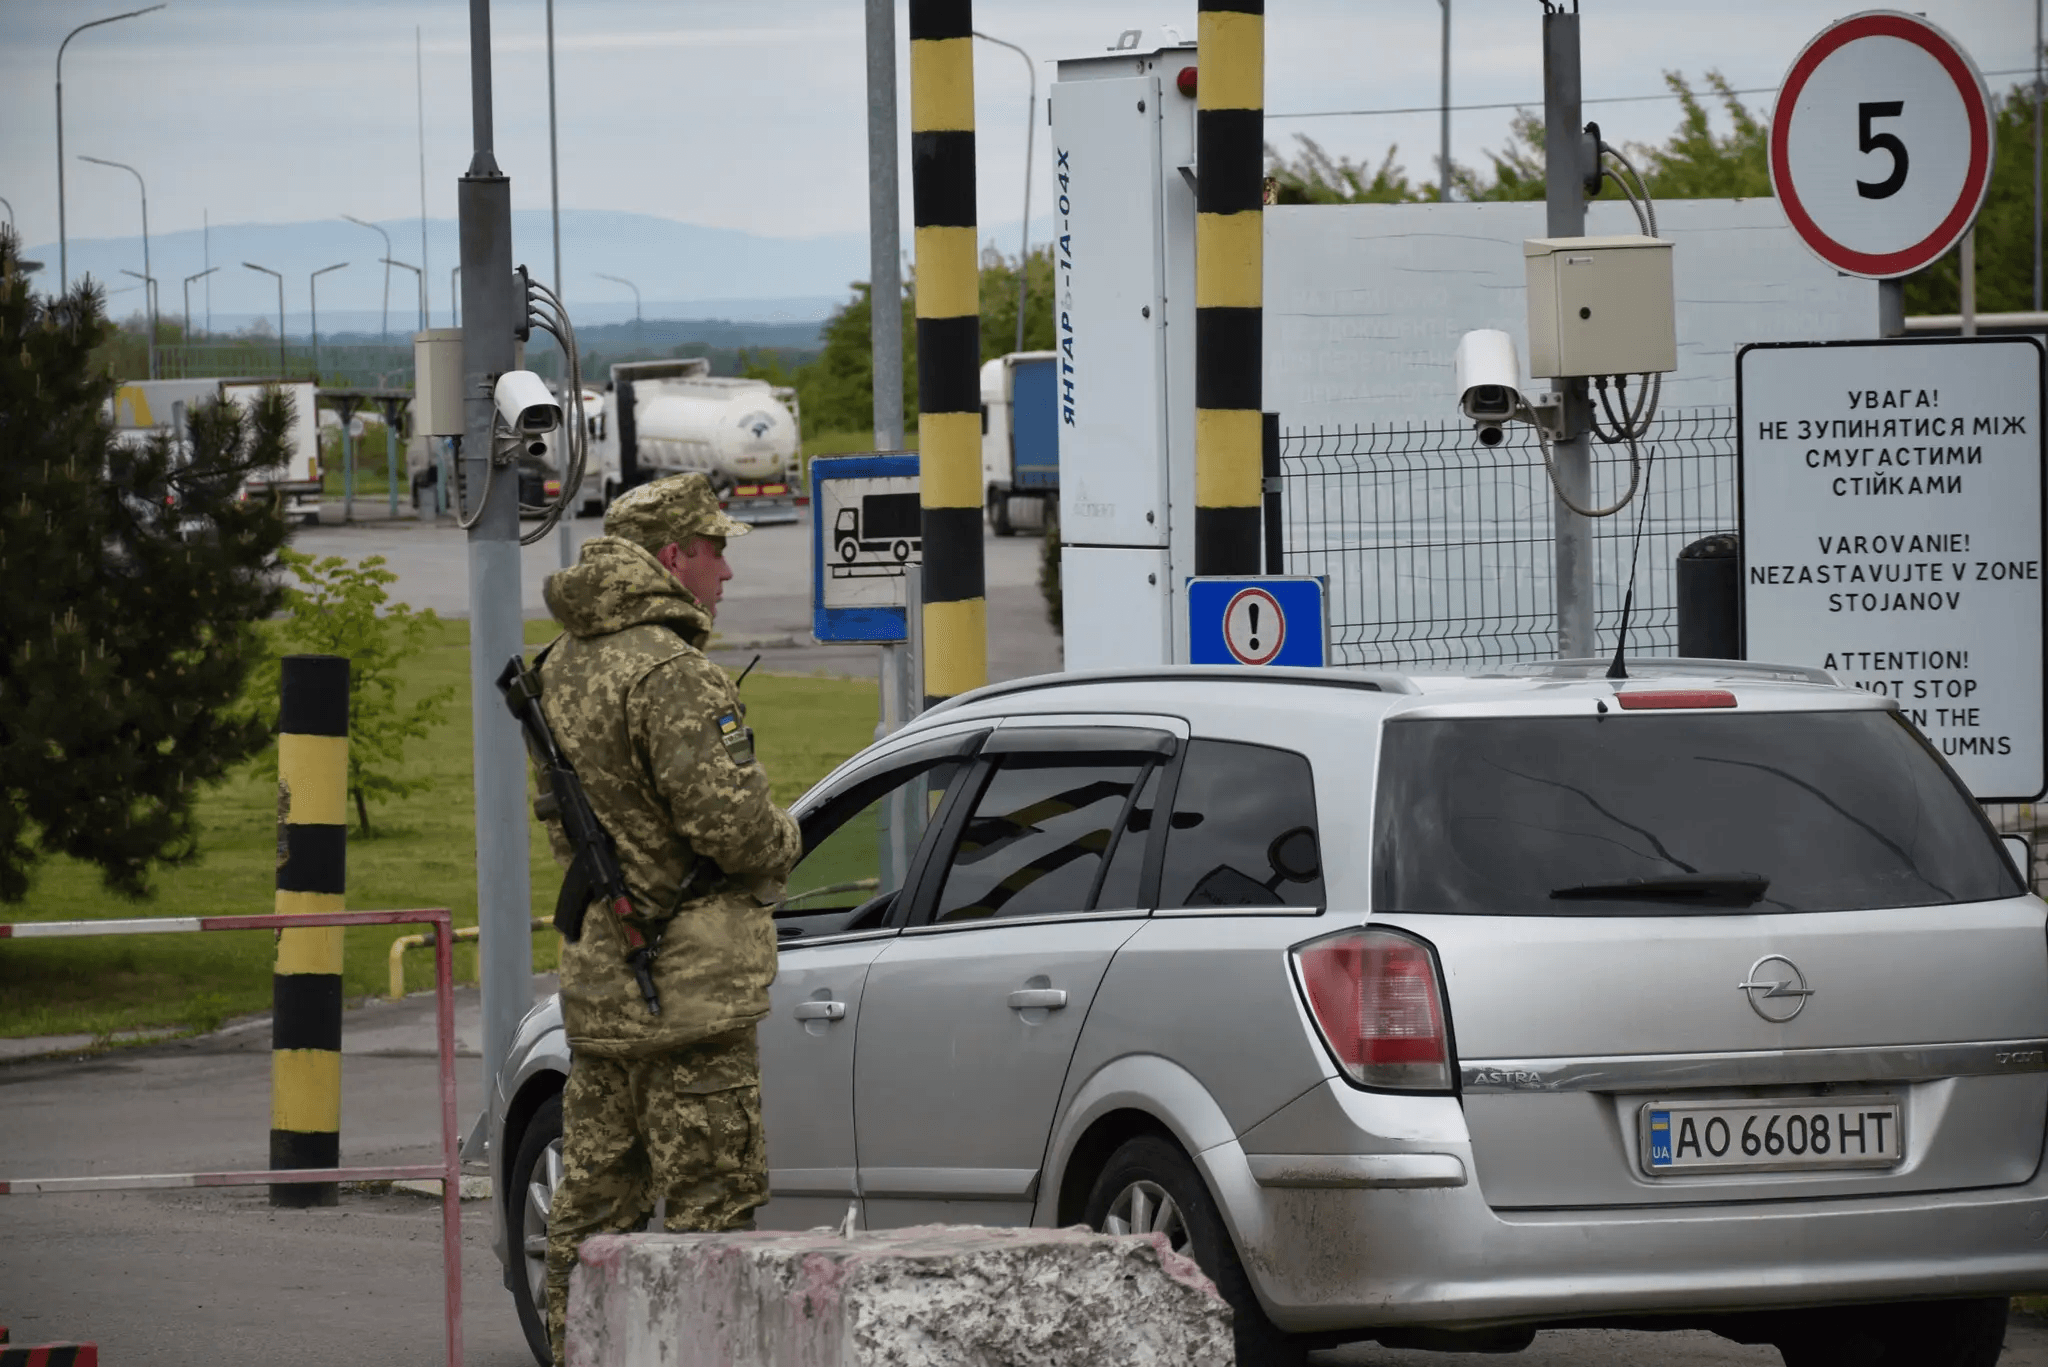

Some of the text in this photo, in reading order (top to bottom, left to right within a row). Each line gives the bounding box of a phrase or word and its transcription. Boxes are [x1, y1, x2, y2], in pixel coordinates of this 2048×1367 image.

[1856, 100, 1910, 200] 5
[1847, 389, 1939, 410] УВАГА!
[1759, 415, 2027, 440] НЕ ЗУПИНЯТИСЯ МІЖ
[1805, 446, 1982, 469] СМУГАСТИМИ
[1832, 471, 1962, 497] СТІЙКАМИ
[1818, 533, 1970, 555] VAROVANIE!
[1750, 560, 2039, 585] NEZASTAVUJTE V ZONE
[1828, 591, 1961, 613] STOJANOV
[1823, 650, 1969, 672] ATTENTION!
[1913, 679, 1978, 699] STOP
[1935, 707, 1981, 727] THE
[1940, 735, 2012, 756] UMNS
[1474, 1071, 1542, 1085] ASTRA
[1676, 1111, 1893, 1158] AO 6608 HT
[1652, 1146, 1670, 1160] UA
